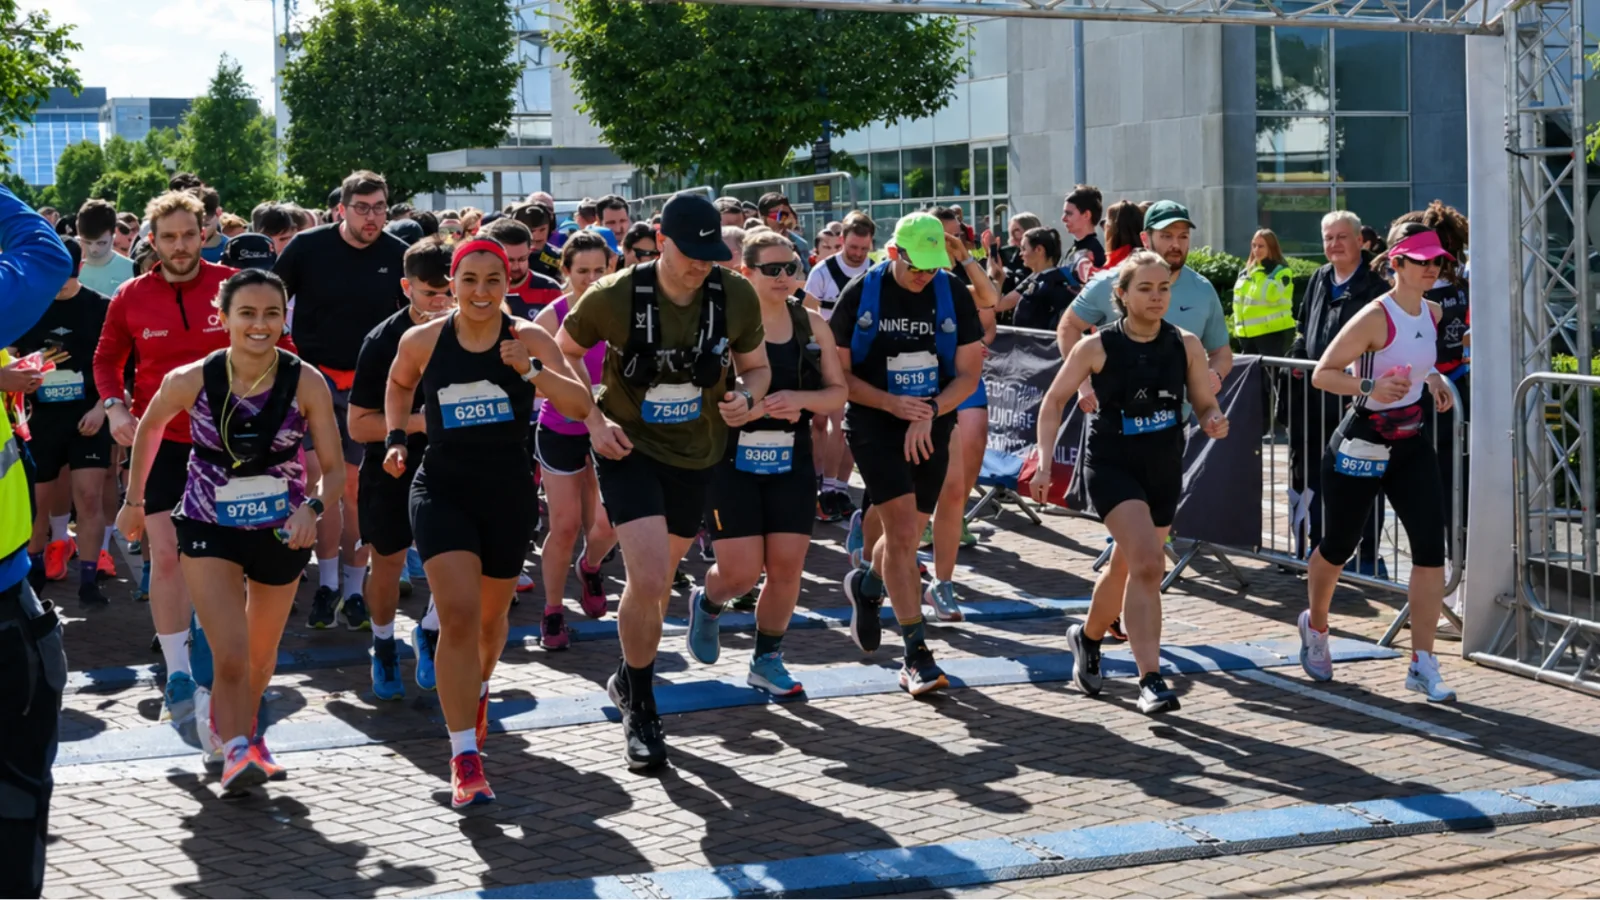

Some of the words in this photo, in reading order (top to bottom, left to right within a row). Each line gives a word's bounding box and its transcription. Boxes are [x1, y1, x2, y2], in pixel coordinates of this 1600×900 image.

[879, 319, 909, 332] NINE
[895, 372, 925, 385] 9619
[455, 403, 495, 420] 6261
[745, 449, 777, 461] 9360
[1342, 457, 1372, 471] 9670
[227, 501, 268, 518] 9784
